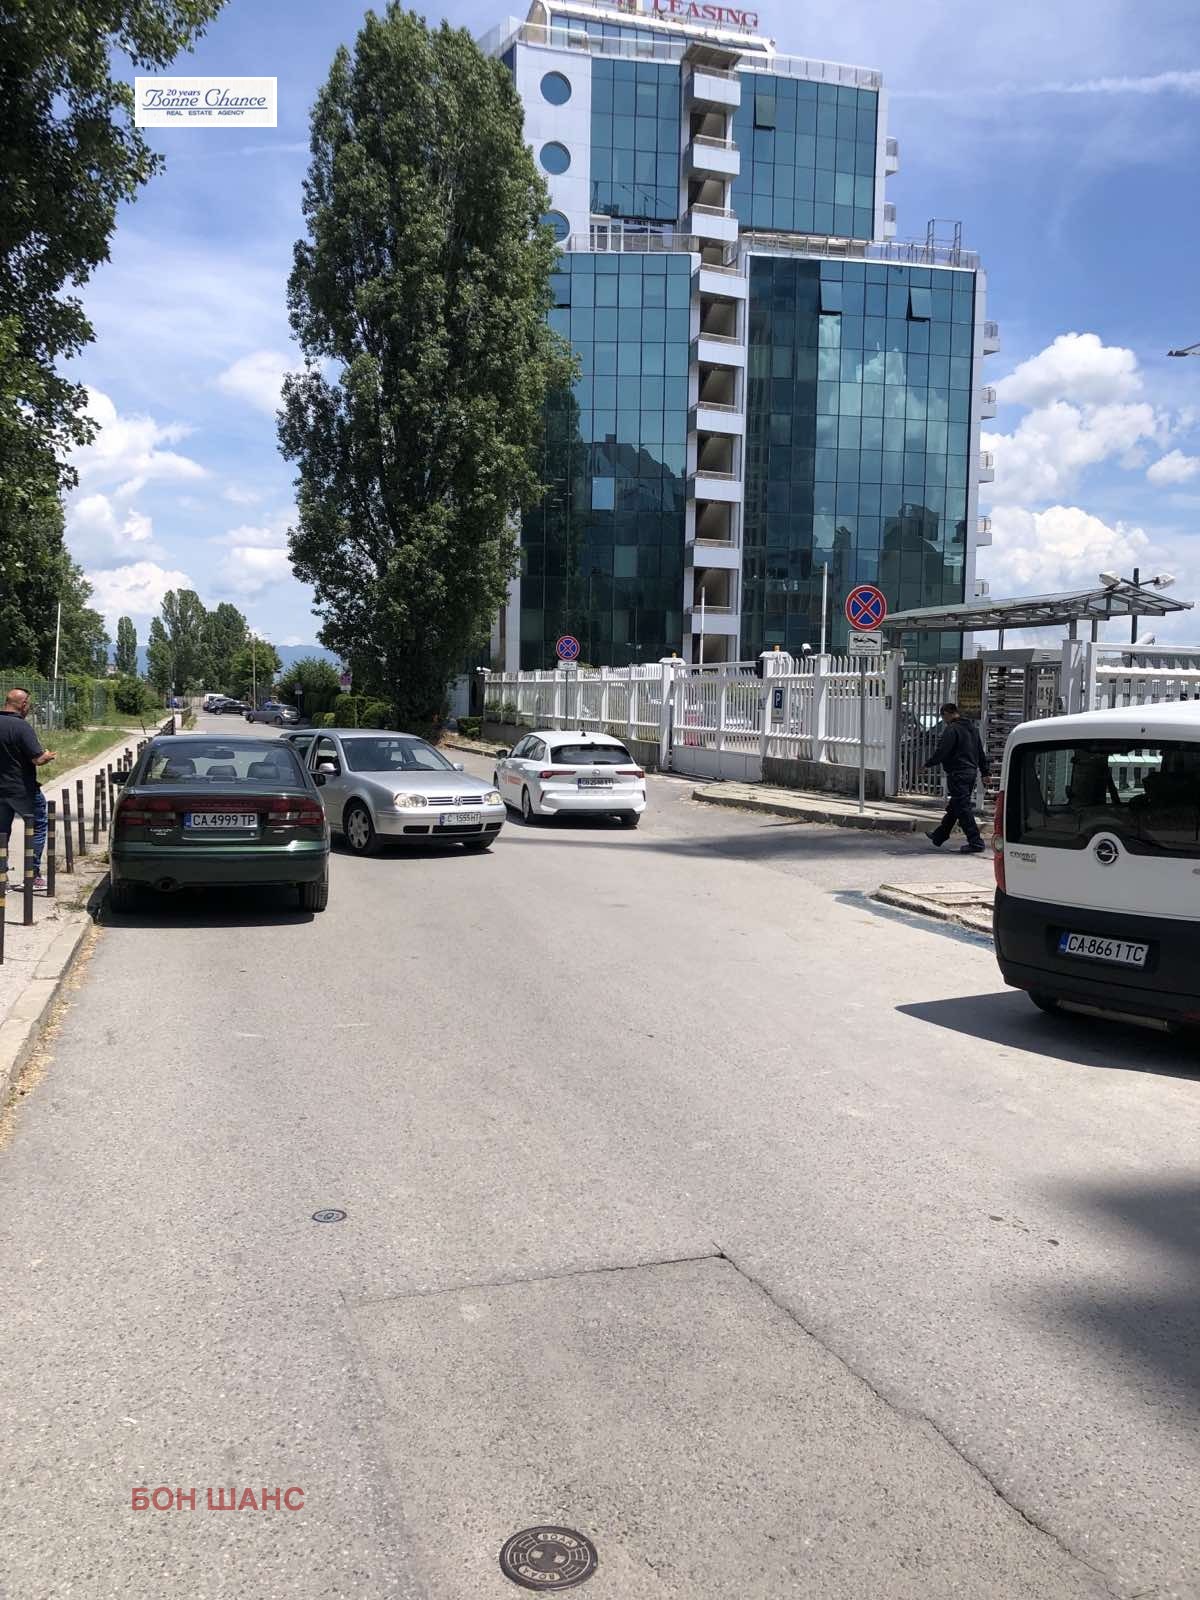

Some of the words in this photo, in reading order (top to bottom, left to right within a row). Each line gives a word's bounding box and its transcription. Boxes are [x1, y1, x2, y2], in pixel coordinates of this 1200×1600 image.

[651, 0, 759, 26] LEASING
[193, 814, 208, 826] CA
[210, 814, 239, 826] 4999
[240, 814, 256, 826] TP
[1125, 944, 1144, 962] TC
